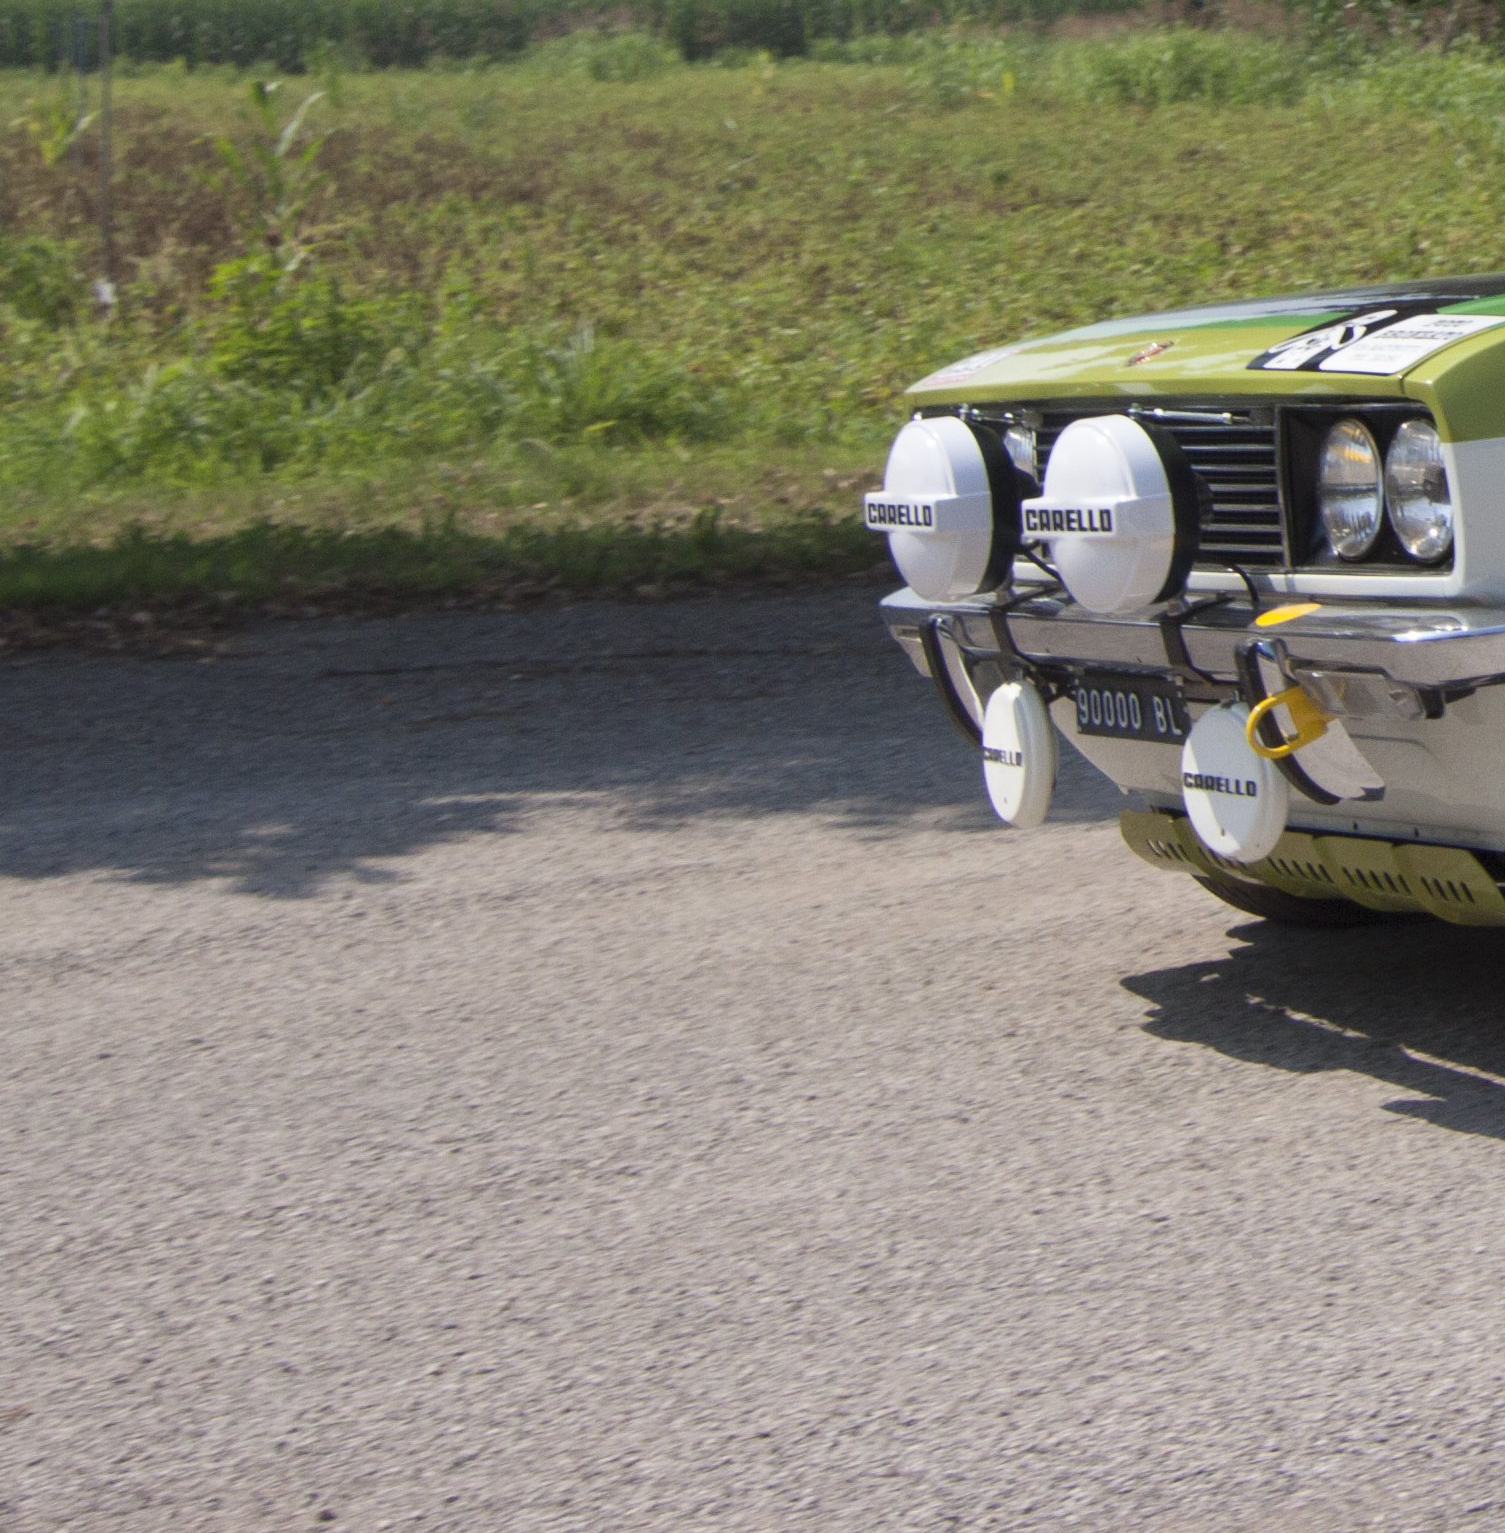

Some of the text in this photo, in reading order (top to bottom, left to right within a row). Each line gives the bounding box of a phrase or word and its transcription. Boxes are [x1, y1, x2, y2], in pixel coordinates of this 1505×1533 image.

[868, 503, 933, 527] CARELLO
[1025, 509, 1113, 533] CARELLO
[1077, 687, 1184, 736] 90000 BL
[1183, 771, 1258, 797] CARELLO
